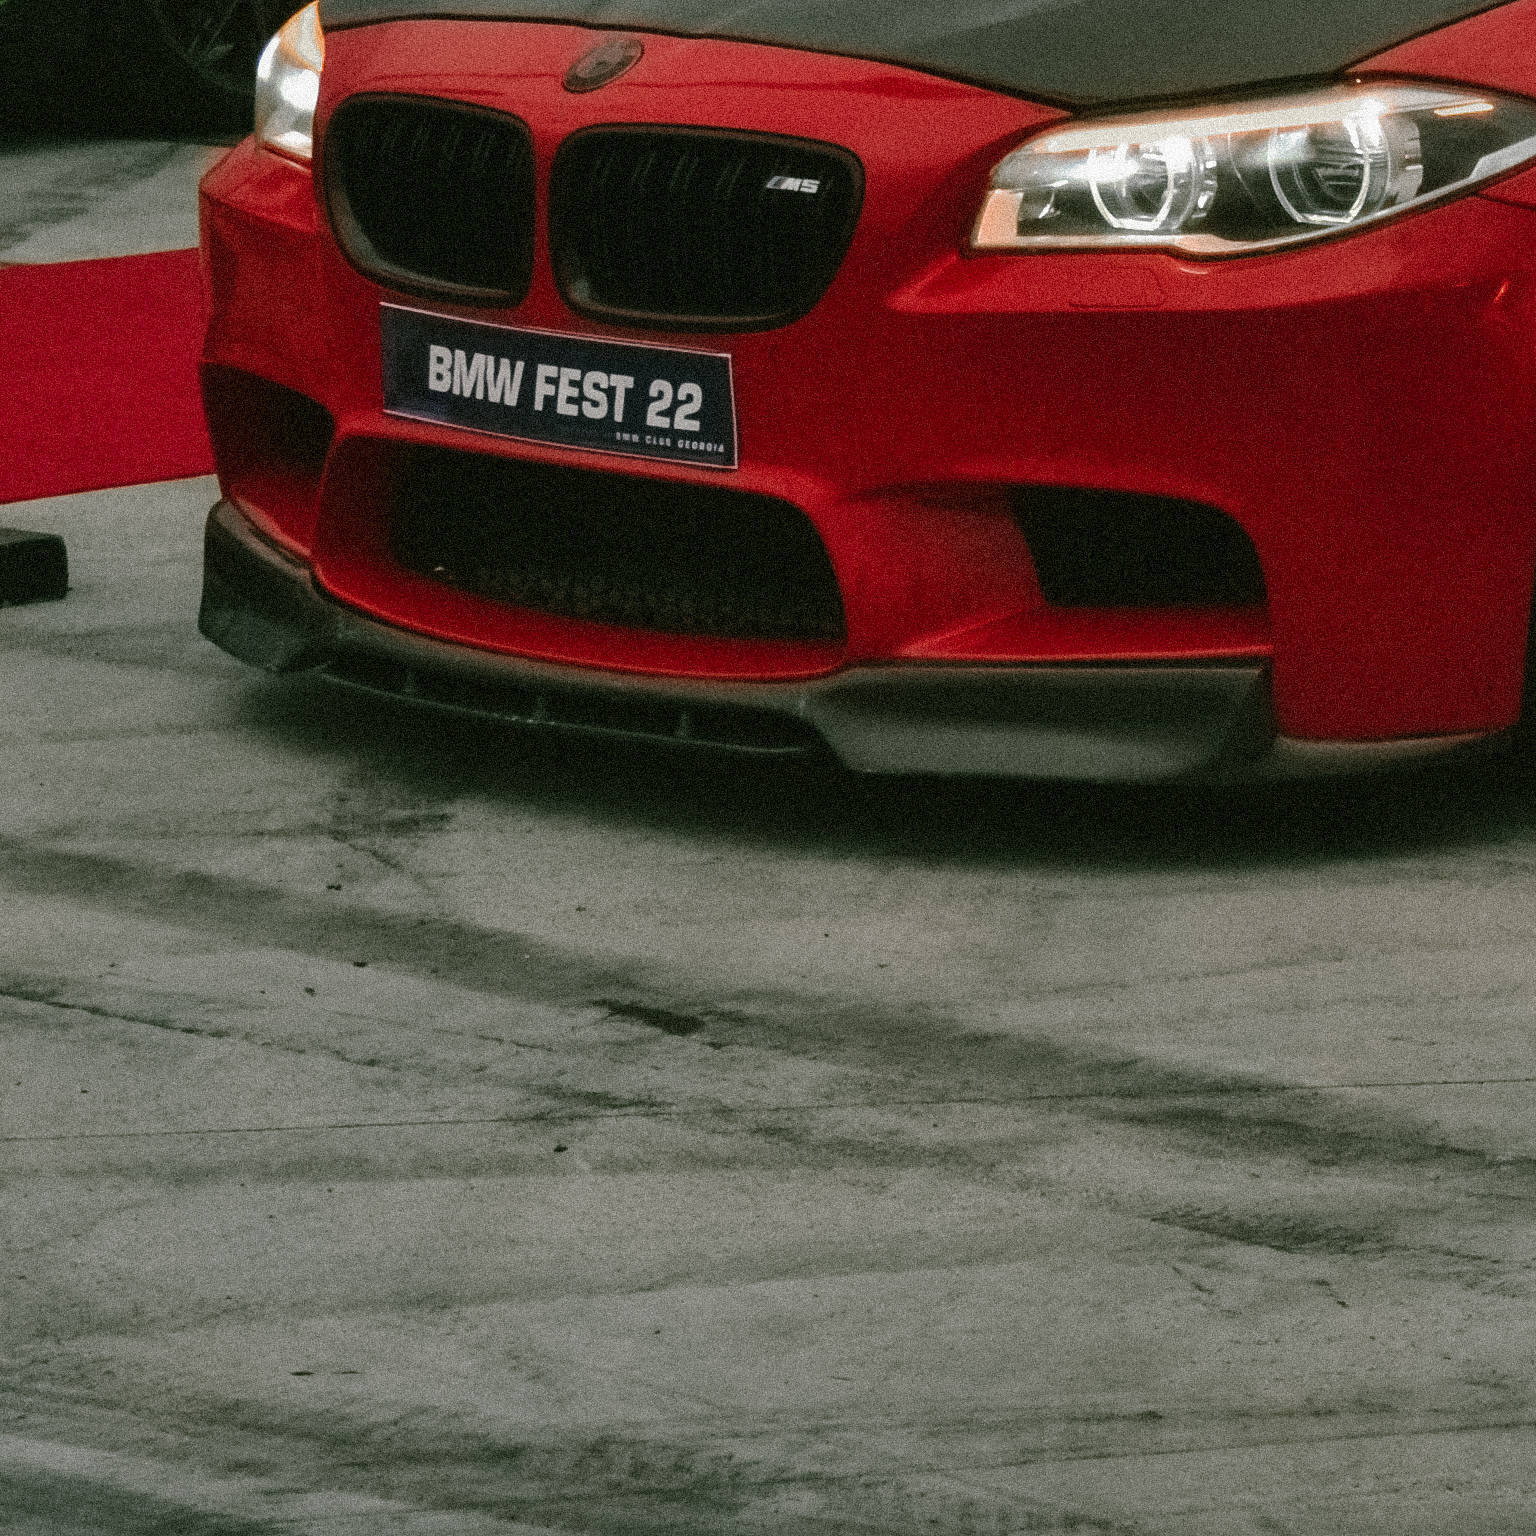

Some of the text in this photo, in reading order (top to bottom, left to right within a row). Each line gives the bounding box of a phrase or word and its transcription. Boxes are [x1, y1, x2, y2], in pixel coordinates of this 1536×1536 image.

[428, 344, 704, 432] BMW FEST 22
[645, 435, 671, 447] CLUB
[677, 439, 725, 453] GEORGIA
